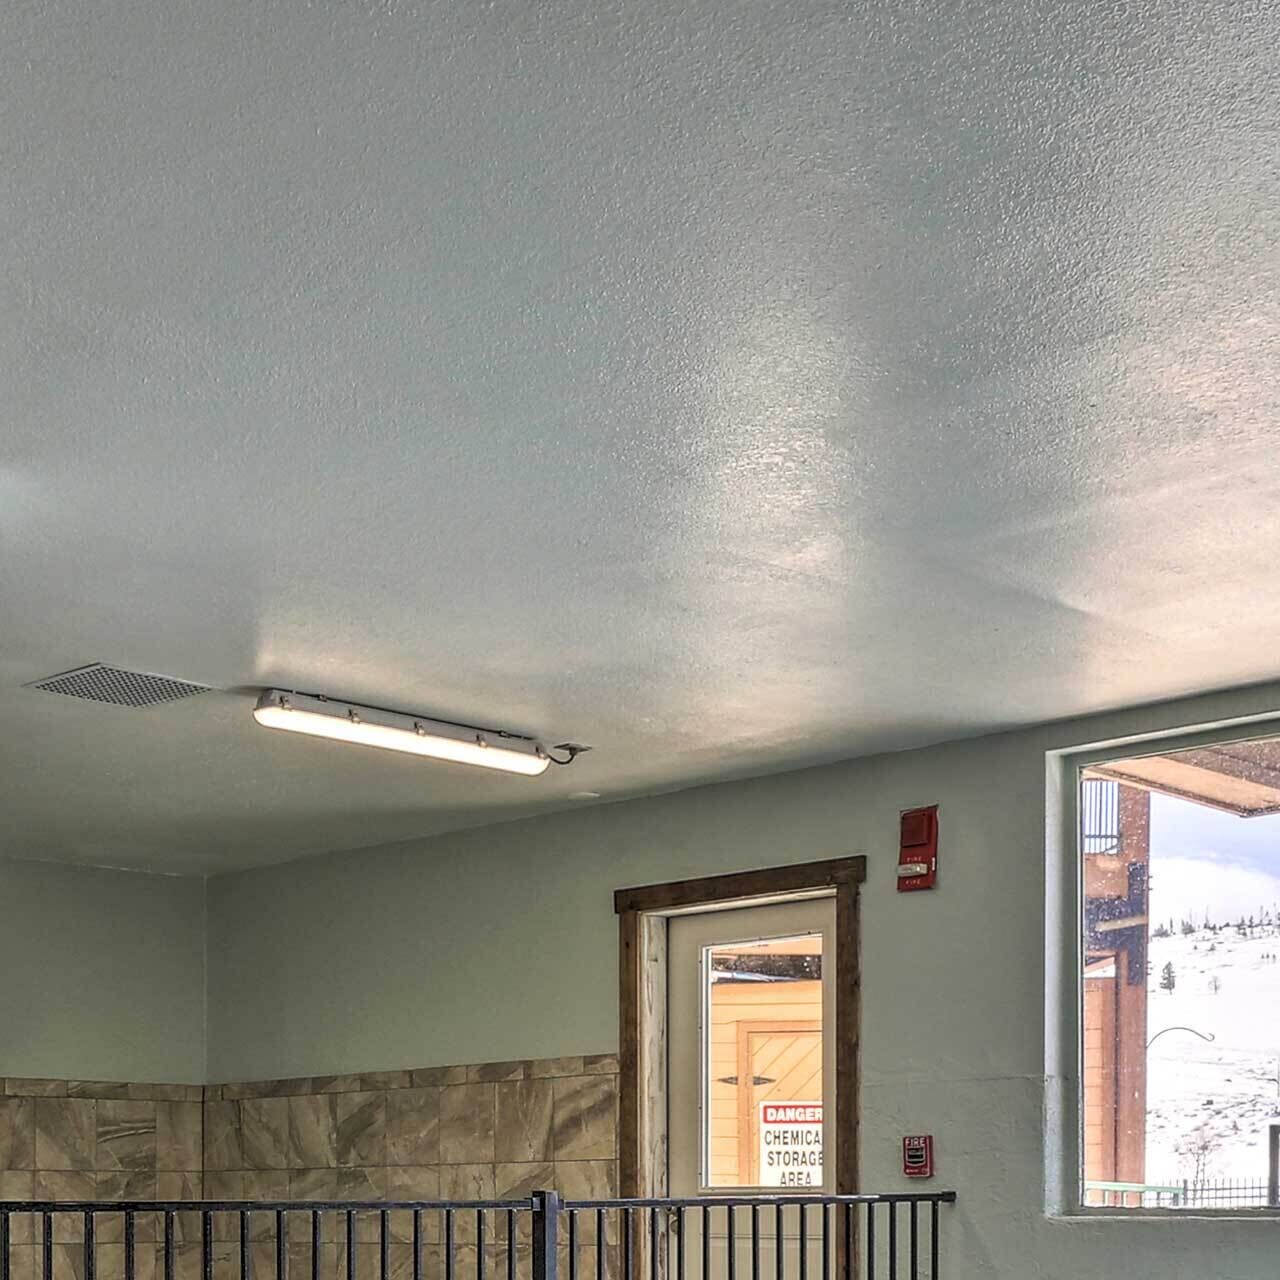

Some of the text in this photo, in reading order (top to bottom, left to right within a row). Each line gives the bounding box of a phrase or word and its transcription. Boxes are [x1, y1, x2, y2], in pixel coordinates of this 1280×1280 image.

[766, 1107, 823, 1121] DANGER
[764, 1130, 822, 1145] CHEMICA
[905, 1137, 925, 1146] FIRE
[767, 1151, 824, 1166] STORAGE
[780, 1171, 812, 1186] AREA
